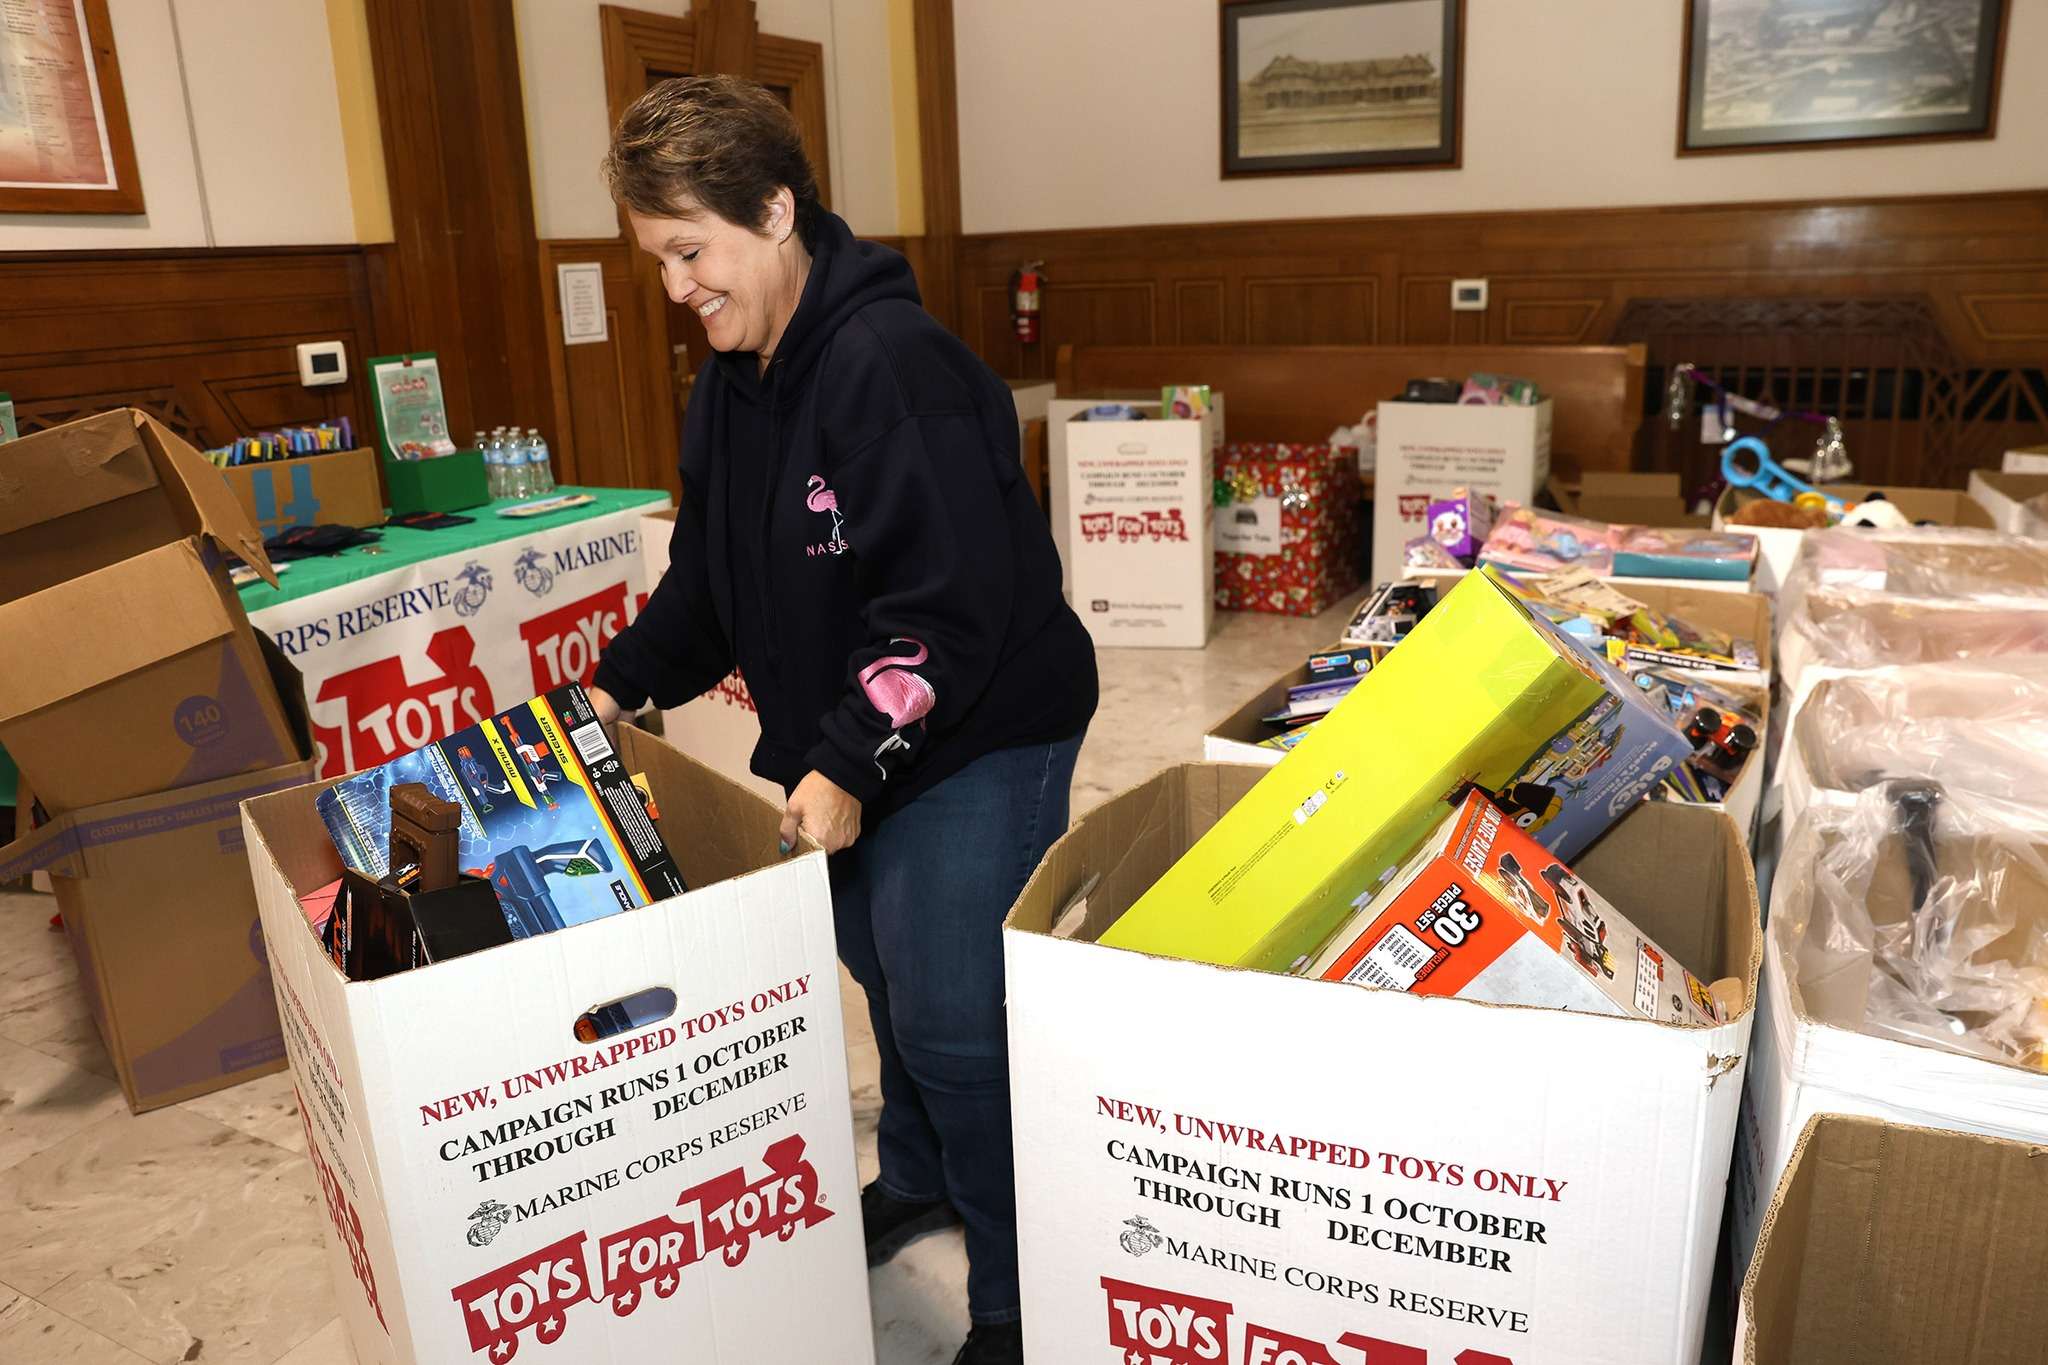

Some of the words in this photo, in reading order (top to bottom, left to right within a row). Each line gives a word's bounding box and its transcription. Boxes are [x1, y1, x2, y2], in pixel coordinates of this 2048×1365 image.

[553, 530, 638, 576] MARINE
[275, 618, 331, 655] RPS
[336, 580, 452, 640] RESERVE
[536, 611, 618, 686] TOYS
[180, 705, 221, 732] 140
[357, 686, 482, 756] TOTS
[540, 717, 568, 764] SKEWER
[497, 747, 517, 778] MANIA
[592, 767, 602, 779] 6+
[1462, 834, 1492, 878] PLAYSET
[1477, 817, 1498, 843] SITE
[615, 884, 633, 911] ANDLE
[1415, 909, 1436, 931] SET
[1432, 884, 1462, 914] PIECE
[1433, 901, 1480, 945] 30
[1415, 949, 1449, 981] INCLUDES
[419, 1085, 497, 1127] NEW,
[502, 1026, 676, 1101] UNWRAPPED
[681, 999, 745, 1047] TOYS
[750, 974, 813, 1014] ONLY
[438, 1092, 593, 1163] CAMPAIGN
[599, 1067, 671, 1109] RUNS
[676, 1063, 687, 1083] 1
[693, 1016, 807, 1076] OCTOBER
[472, 1118, 616, 1182] THROUGH
[653, 1052, 790, 1121] DECEMBER
[514, 1169, 621, 1222] MARINE
[625, 1137, 704, 1180] CORPS
[709, 1092, 807, 1144] RESERVE
[1096, 1095, 1167, 1135] NEW,
[1174, 1113, 1370, 1171] UNWRAPPED
[1378, 1152, 1464, 1187] TOYS
[1473, 1167, 1568, 1203] ONLY
[1106, 1139, 1262, 1192] CAMPAIGN
[1270, 1176, 1352, 1211] RUNS
[1361, 1194, 1374, 1215] 1
[1383, 1198, 1548, 1245] OCTOBER
[467, 1257, 580, 1332] TOYS
[606, 1226, 684, 1282] FOR
[709, 1175, 805, 1240] TOTS
[1133, 1176, 1281, 1229] THROUGH
[1327, 1219, 1513, 1273] DECEMBER
[1165, 1237, 1277, 1281] MARINE
[1284, 1266, 1379, 1304] CORPS
[1388, 1287, 1529, 1334] RESERVE
[1112, 1298, 1221, 1360] TOYS
